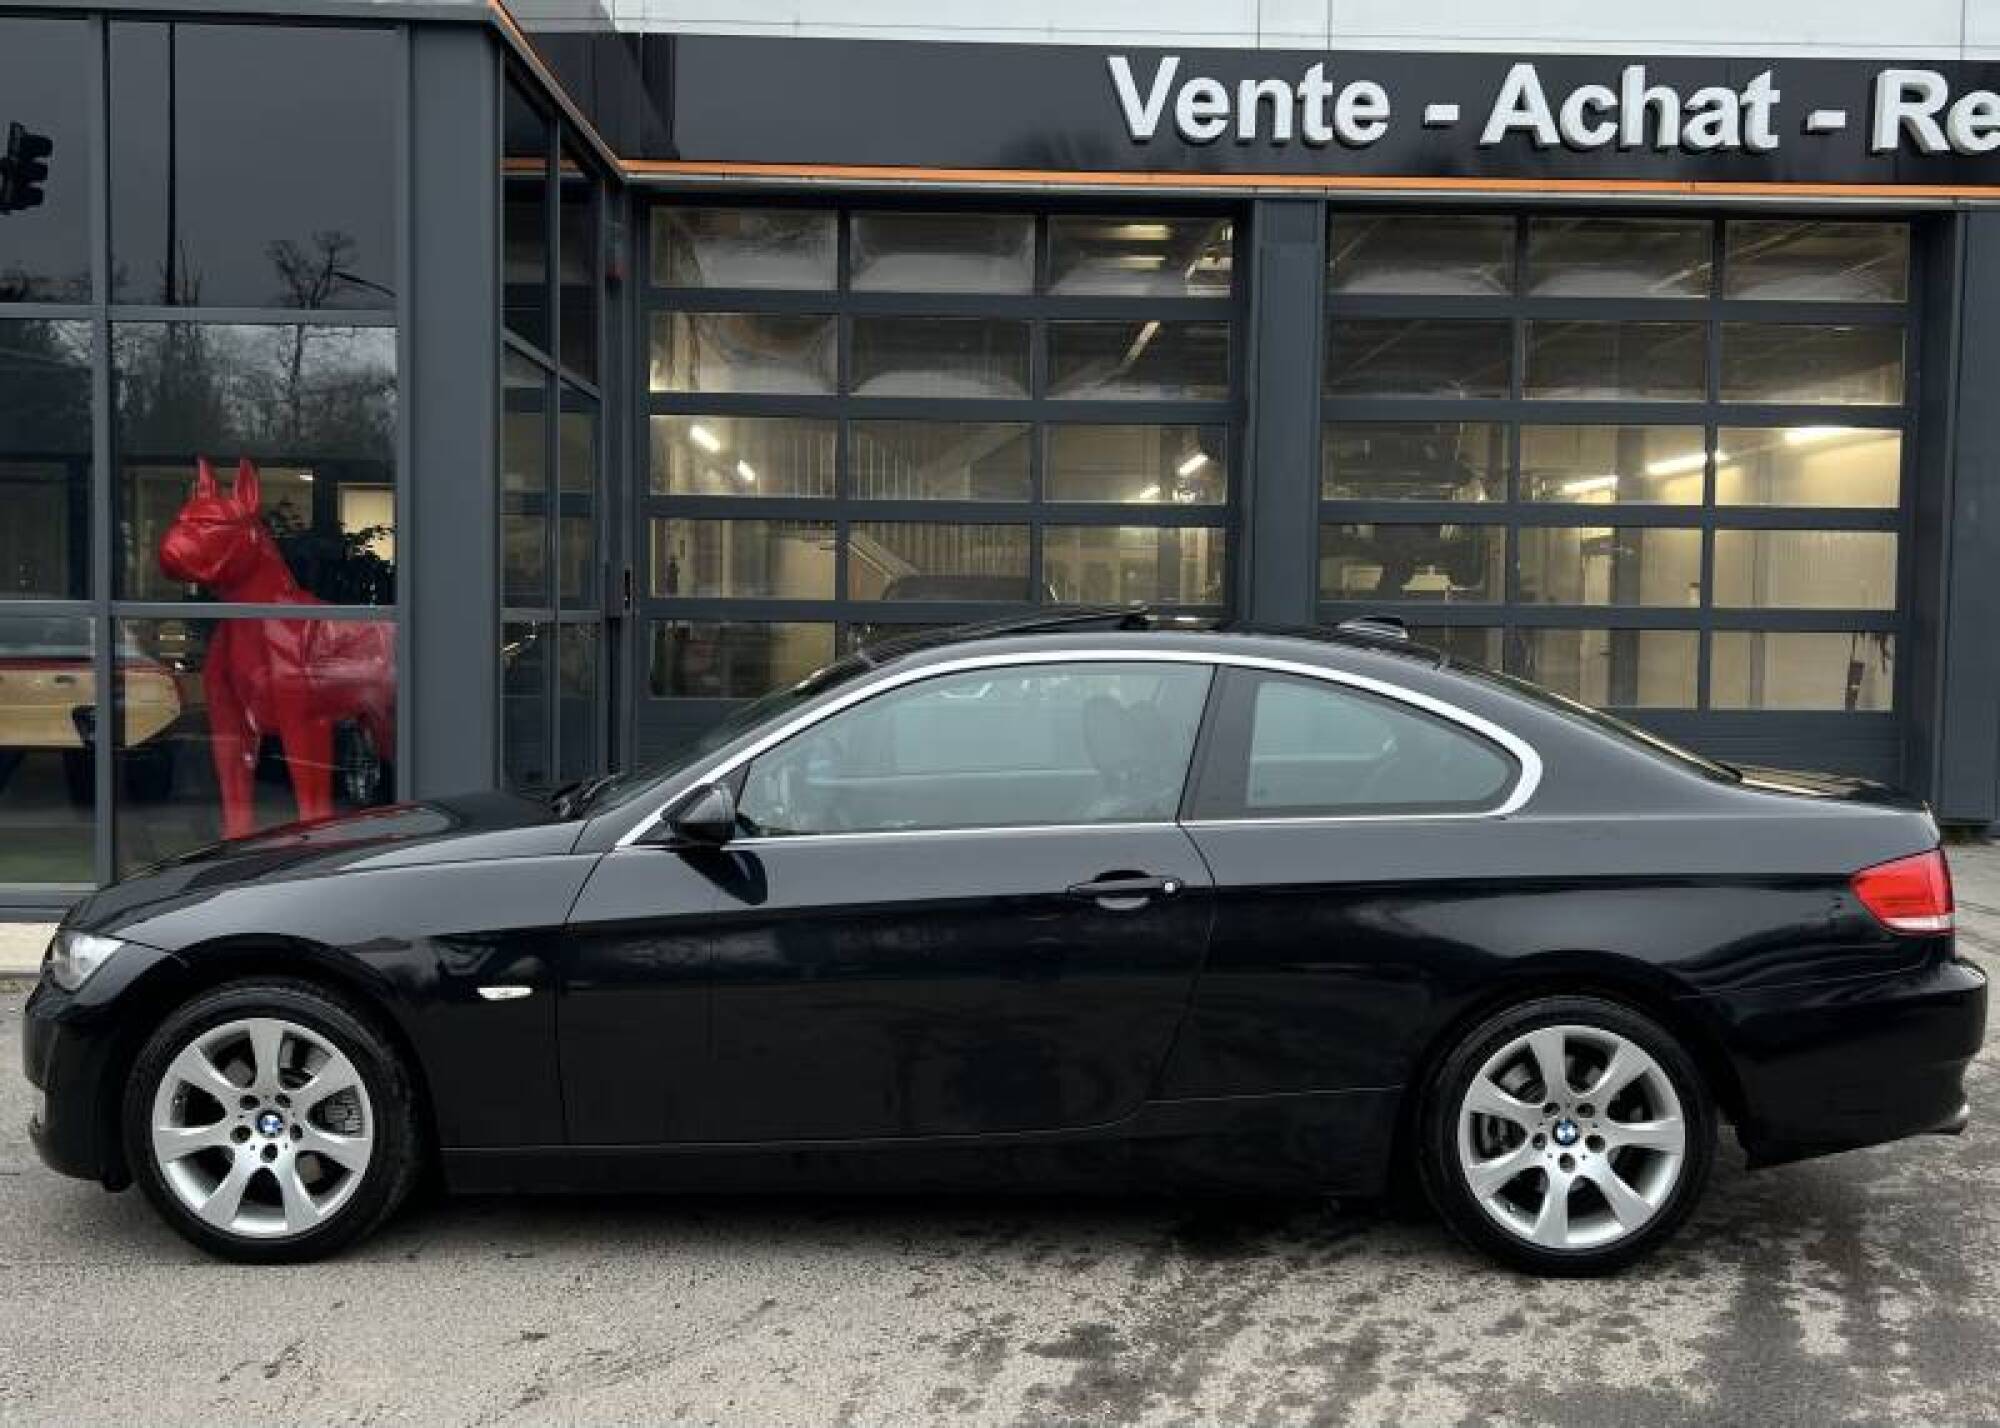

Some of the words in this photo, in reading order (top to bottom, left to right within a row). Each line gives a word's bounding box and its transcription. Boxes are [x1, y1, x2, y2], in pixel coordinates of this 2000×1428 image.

[1106, 55, 1391, 143] Vente
[1424, 103, 1461, 124] -
[1479, 62, 1781, 149] Achat
[1806, 109, 1847, 132] -
[1871, 69, 2000, 154] Re
